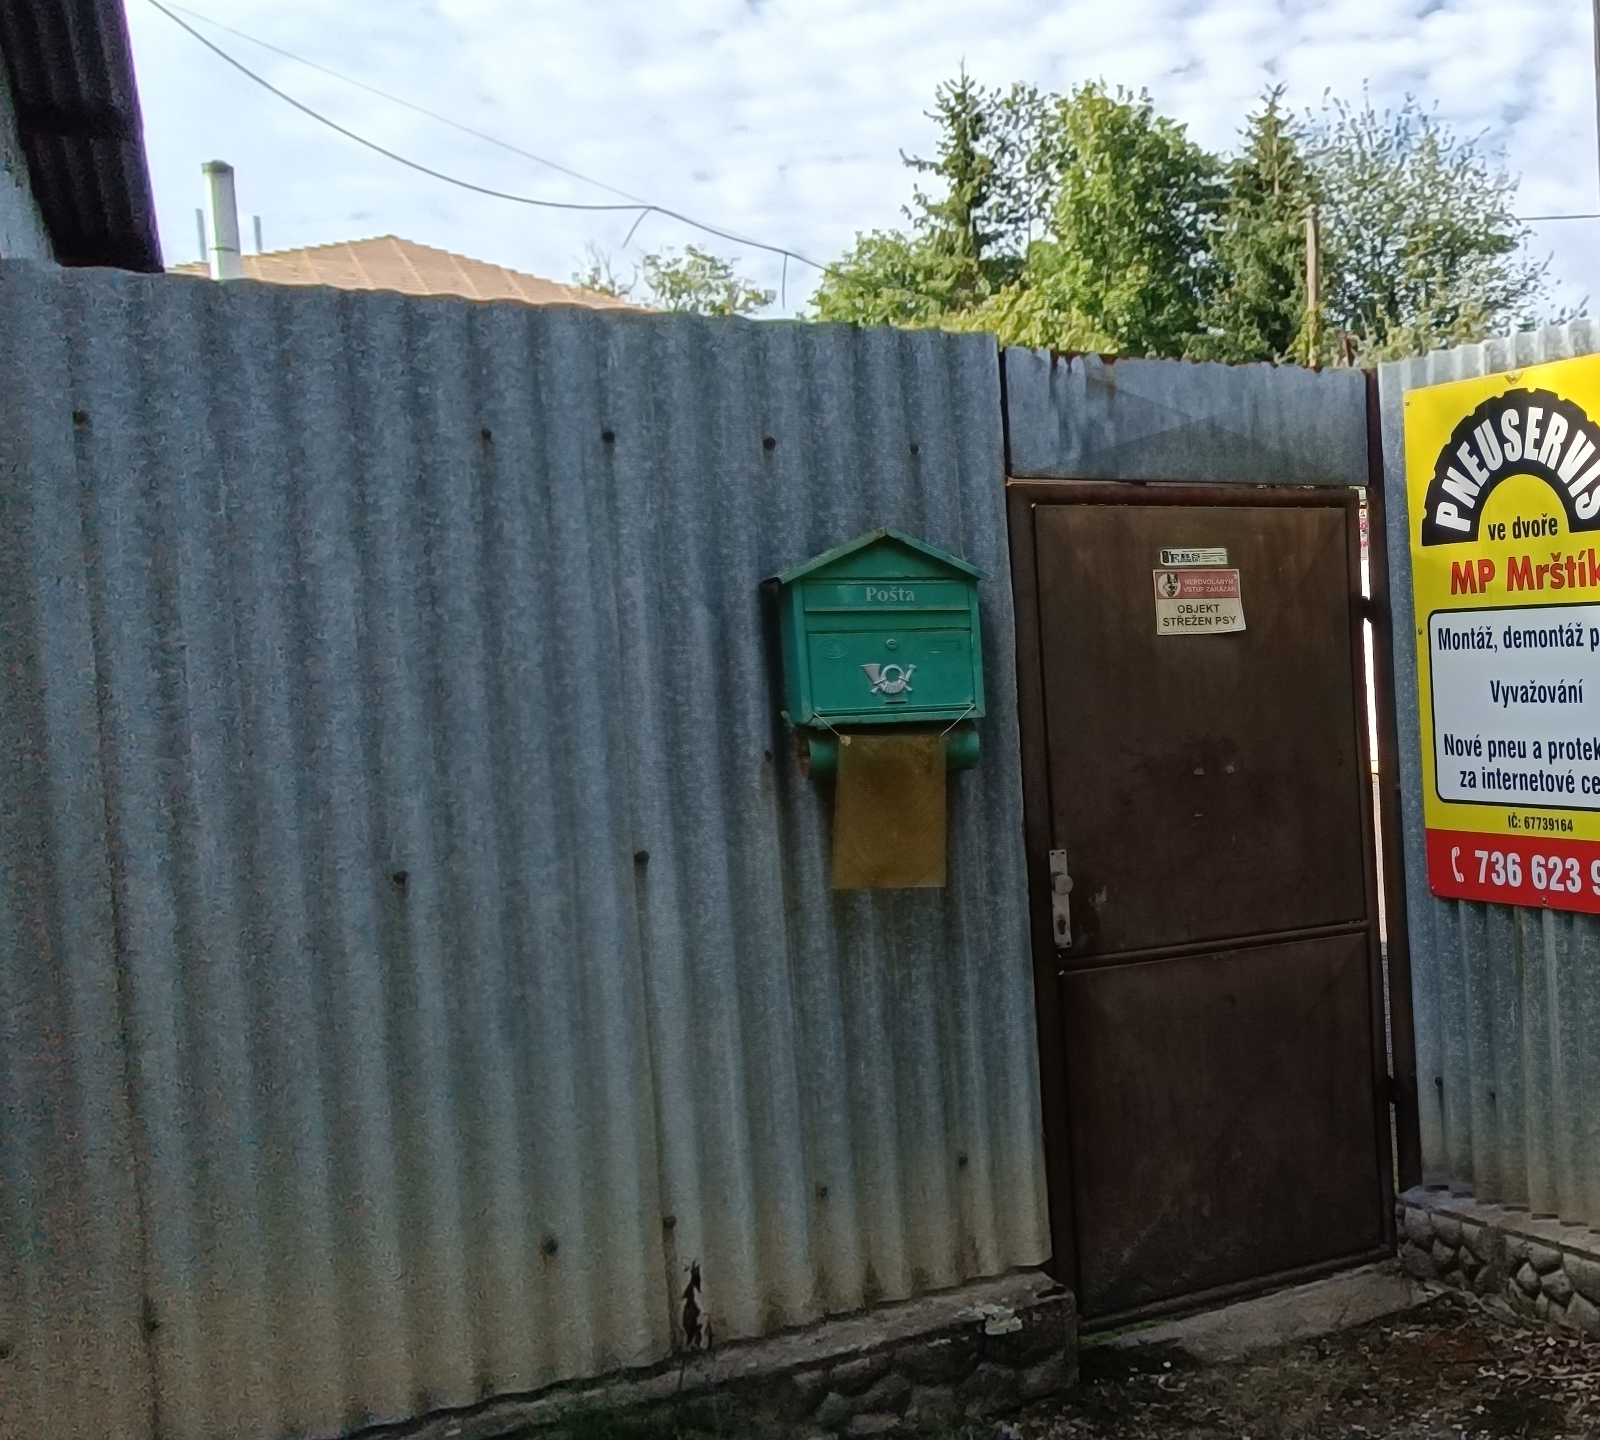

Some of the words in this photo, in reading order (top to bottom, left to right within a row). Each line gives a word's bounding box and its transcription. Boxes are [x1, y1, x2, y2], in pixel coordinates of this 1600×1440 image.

[1488, 523, 1506, 541] ve
[1512, 513, 1558, 540] dvoře
[1450, 559, 1496, 595] MP
[865, 586, 916, 602] Pošta
[1162, 615, 1212, 627] STŘEŽEN
[1215, 616, 1237, 625] PSY
[1177, 604, 1220, 614] OBJEKT
[1438, 626, 1498, 653] Montáž,
[1503, 622, 1584, 649] demontáž
[1490, 679, 1584, 708] Vyvažování
[1443, 733, 1482, 758] Nové
[1487, 740, 1526, 762] pneu
[1532, 741, 1542, 760] a
[1459, 769, 1477, 789] za
[1481, 766, 1576, 795] internetové
[1507, 814, 1521, 829] IČ:
[1524, 815, 1574, 832] 67739164
[1474, 849, 1523, 887] 736
[1531, 854, 1582, 893] 623
